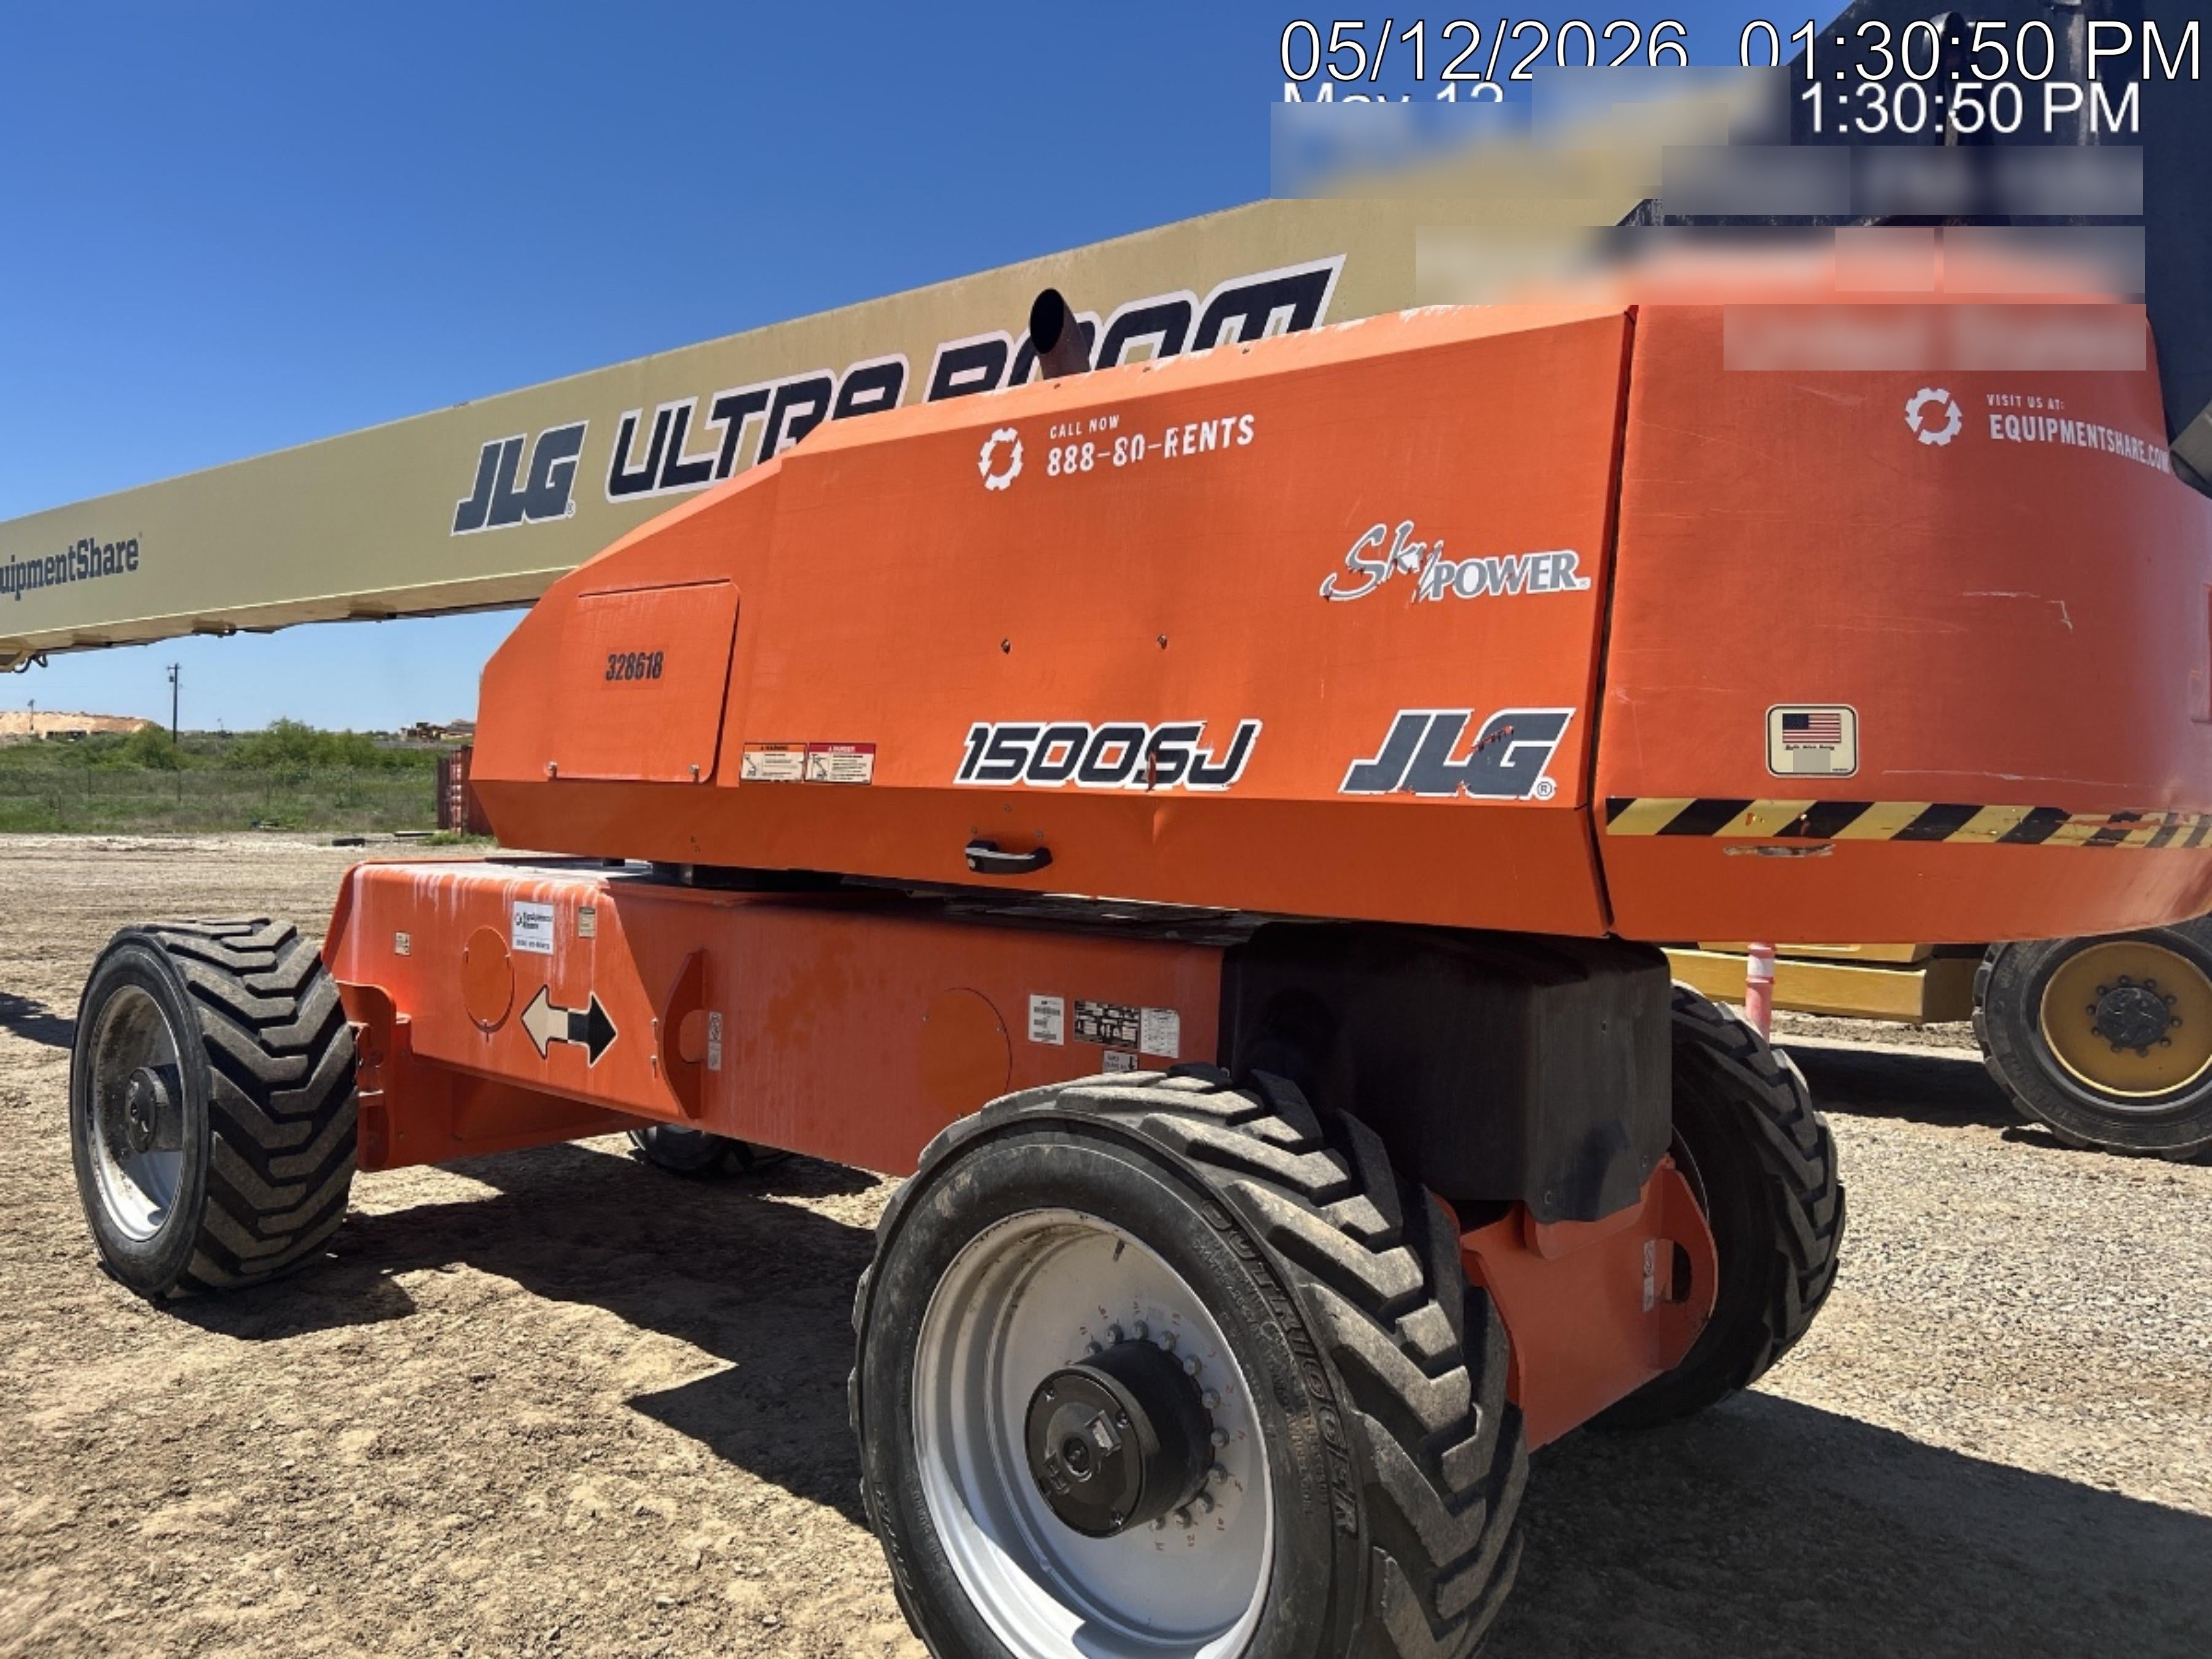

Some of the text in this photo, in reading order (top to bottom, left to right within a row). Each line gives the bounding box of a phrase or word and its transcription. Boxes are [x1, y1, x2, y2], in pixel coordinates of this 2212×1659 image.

[1049, 415, 1120, 439] CALL NOW
[1986, 394, 2065, 410] VISIT US AT:
[1047, 414, 1255, 476] 888-80-RENTS
[1989, 413, 2171, 474] EQUIPMENTSHARE.COM
[452, 420, 588, 536] JLG
[606, 650, 664, 681] 328618
[953, 719, 1263, 791] 1500SJ
[1338, 708, 1577, 800] JLG
